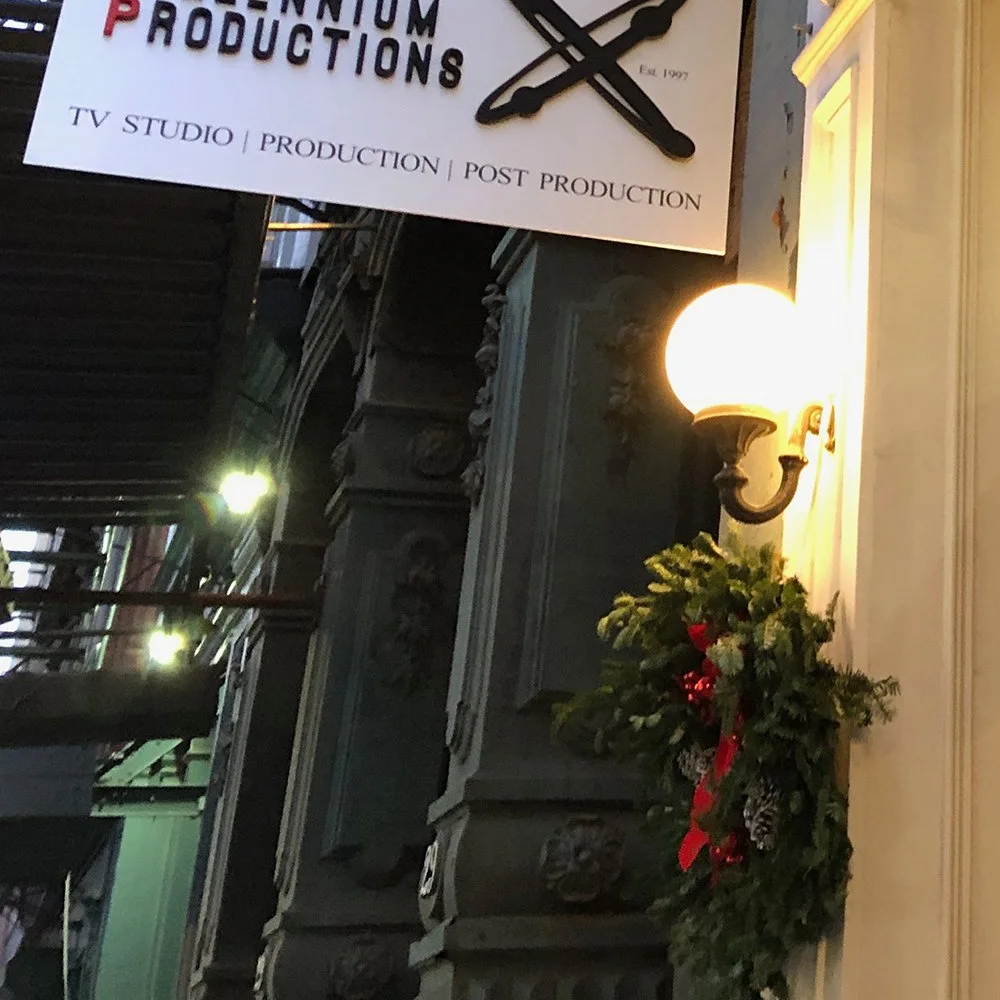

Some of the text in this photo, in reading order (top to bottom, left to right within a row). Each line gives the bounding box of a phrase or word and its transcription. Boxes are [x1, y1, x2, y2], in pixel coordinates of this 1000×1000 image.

[663, 68, 689, 81] 1997
[69, 105, 702, 212] TV STUDIO PRODUCTION POST PRODUCTION
